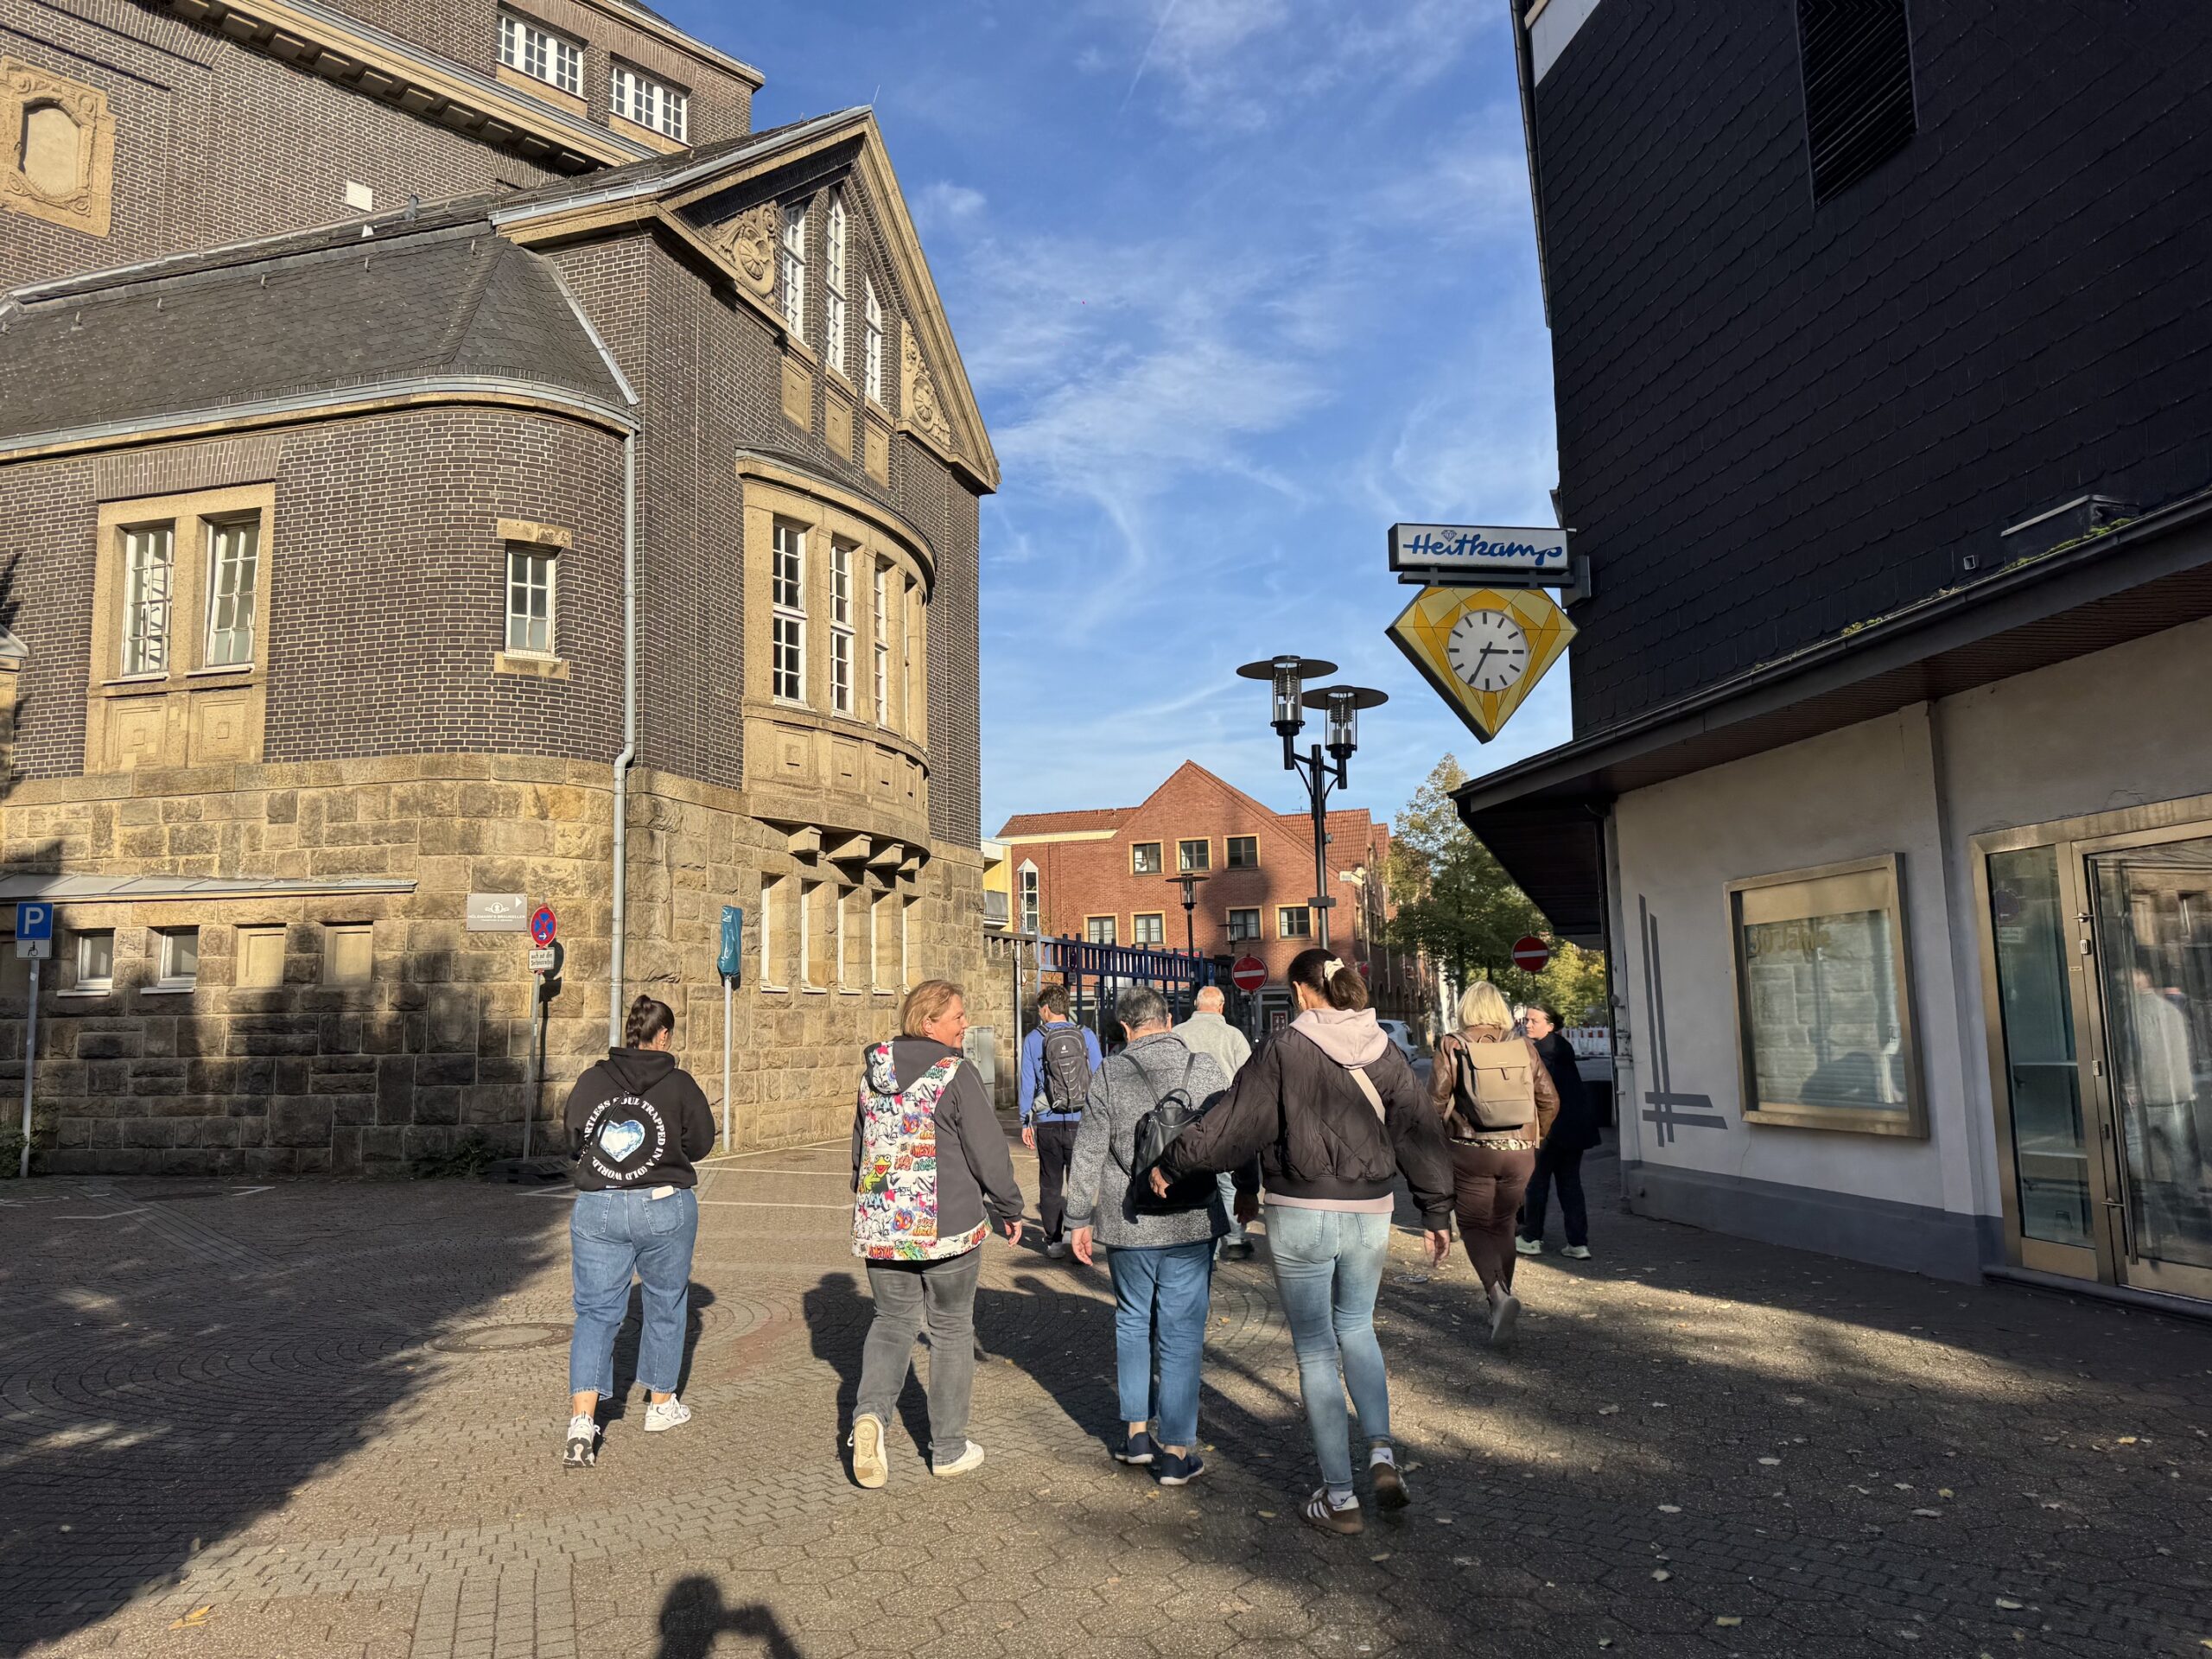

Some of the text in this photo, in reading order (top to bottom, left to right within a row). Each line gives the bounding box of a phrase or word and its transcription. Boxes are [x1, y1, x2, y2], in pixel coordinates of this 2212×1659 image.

[1402, 530, 1563, 566] Heitkamp
[23, 906, 45, 935] P
[641, 1100, 666, 1146] TRAPPED
[645, 1158, 655, 1166] A
[652, 1147, 664, 1161] IN
[625, 1166, 648, 1180] COLD
